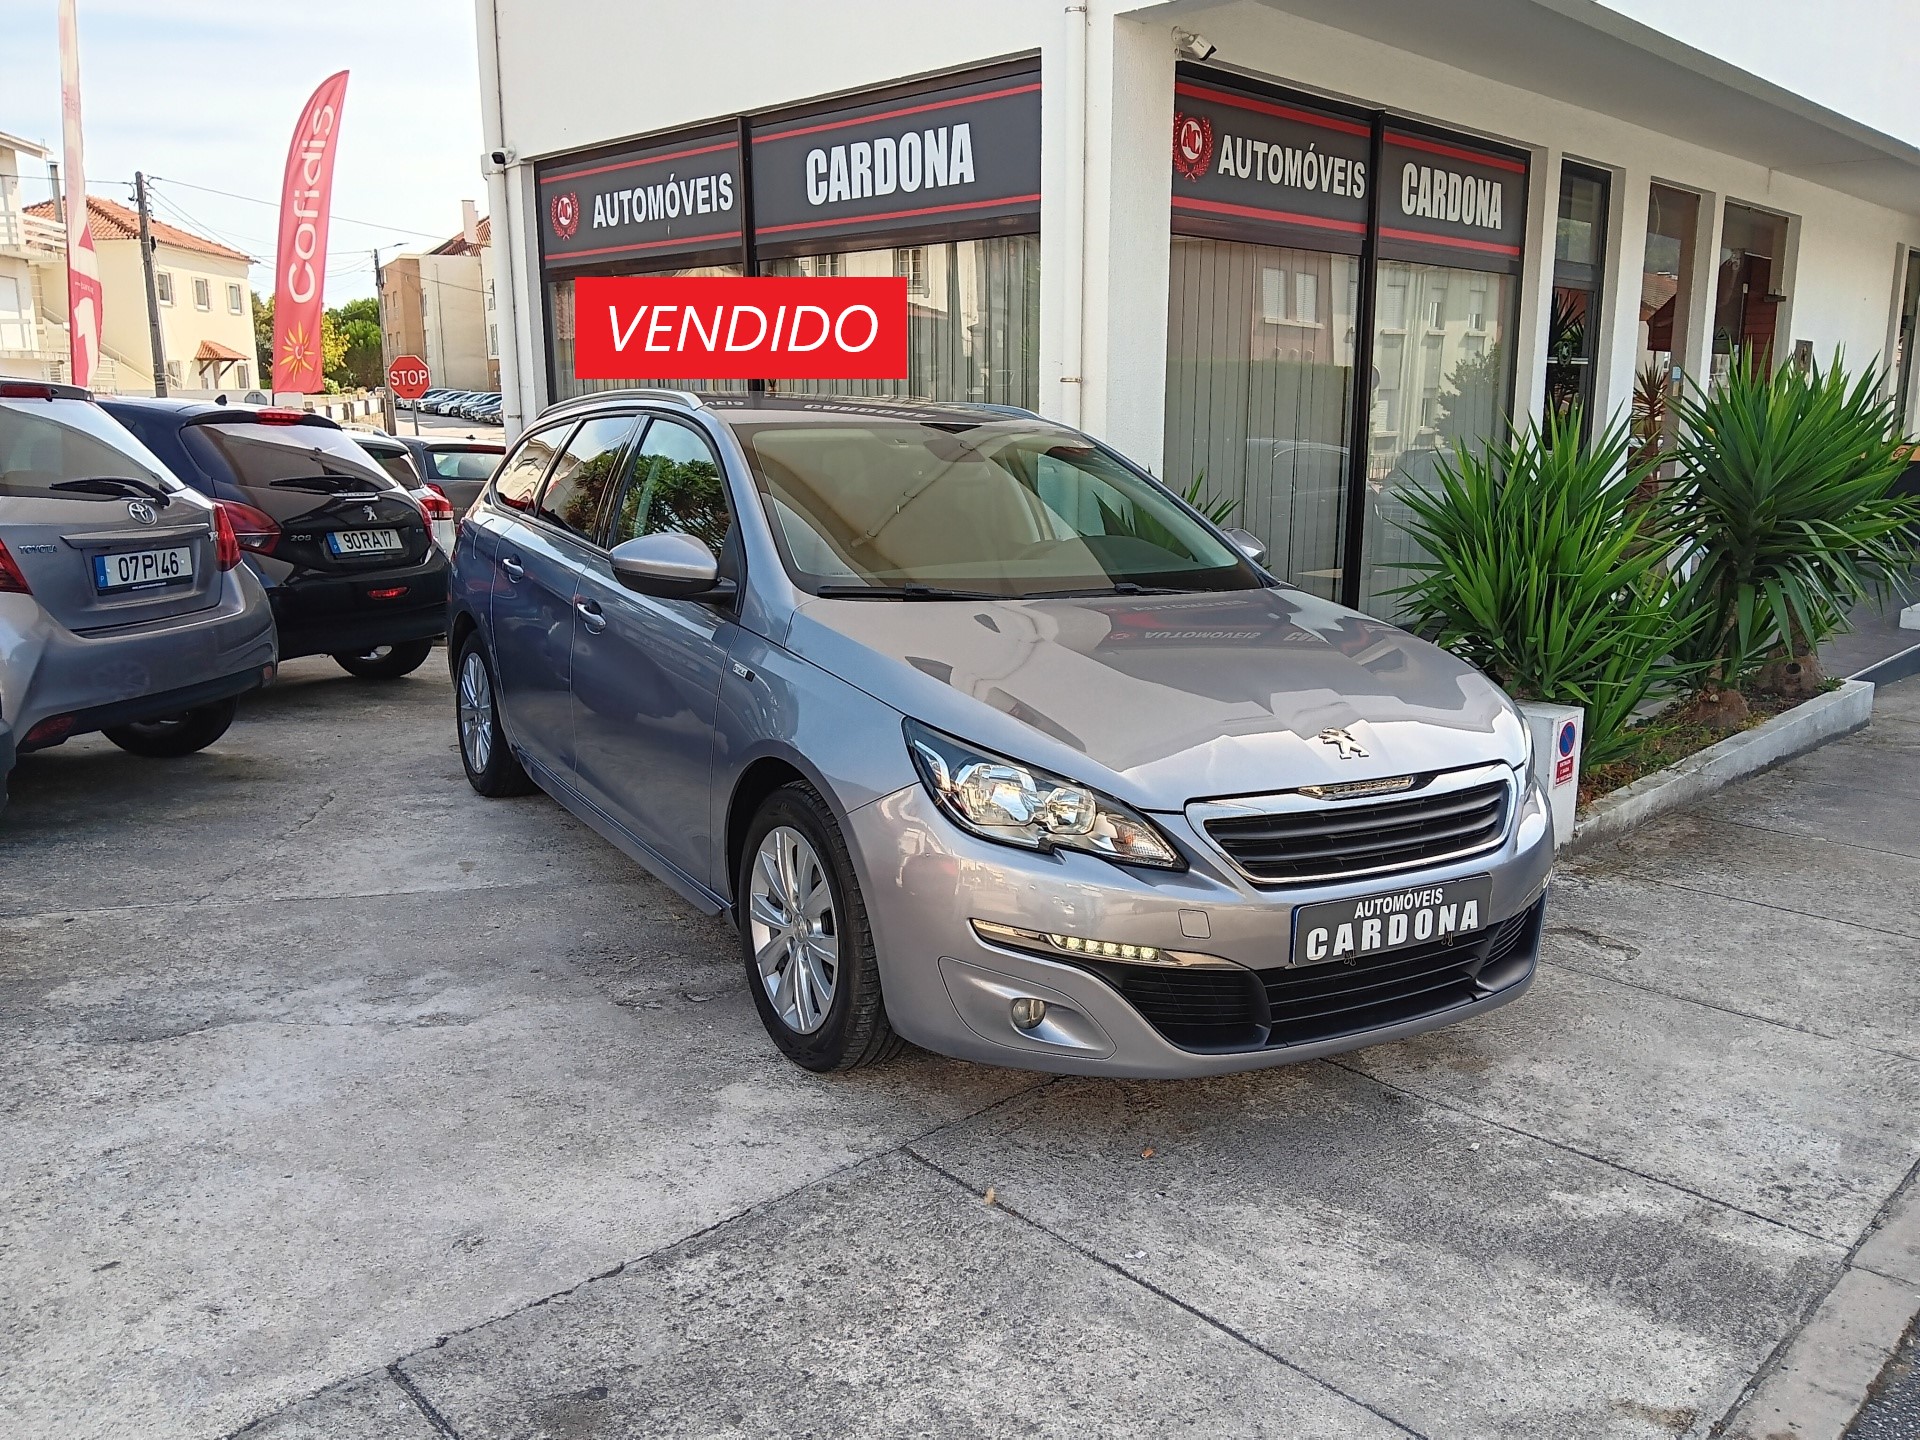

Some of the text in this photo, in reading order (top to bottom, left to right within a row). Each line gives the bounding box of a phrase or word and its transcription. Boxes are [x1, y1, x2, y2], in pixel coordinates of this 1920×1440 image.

[288, 105, 335, 304] Cofidis
[592, 172, 734, 229] AUTOMÓVEIS
[806, 122, 976, 206] CARDONA
[1217, 134, 1366, 198] AUTOMÓVEIS
[1401, 162, 1503, 230] CARDONA
[390, 369, 429, 386] STOP
[18, 545, 57, 555] TOYOTA
[1306, 899, 1479, 961] CARDONA
[1353, 886, 1444, 920] AUTOMÓVEIS
